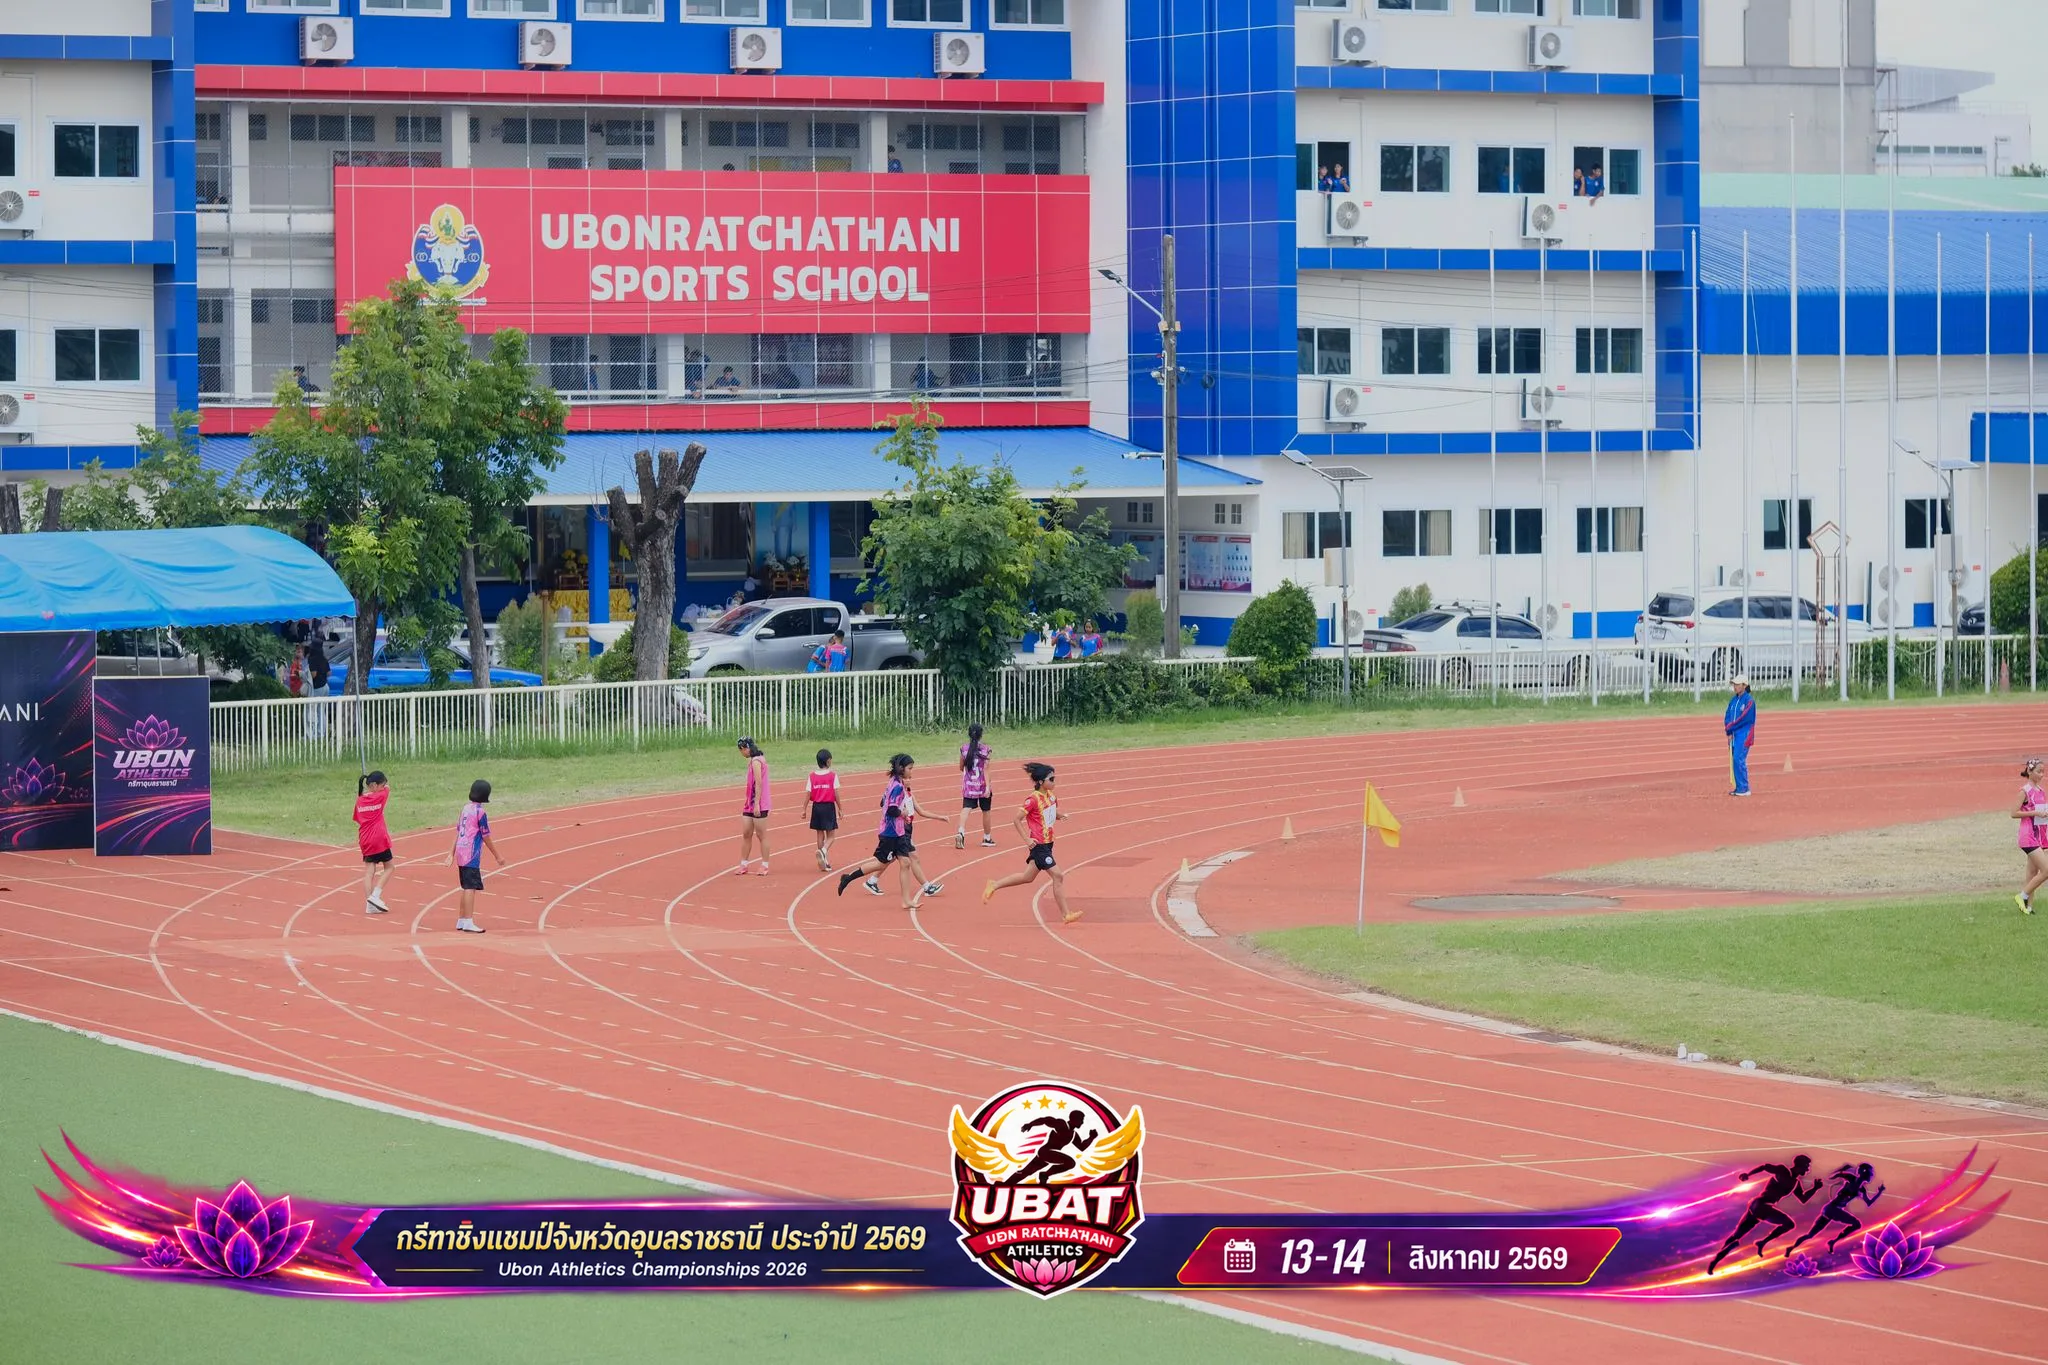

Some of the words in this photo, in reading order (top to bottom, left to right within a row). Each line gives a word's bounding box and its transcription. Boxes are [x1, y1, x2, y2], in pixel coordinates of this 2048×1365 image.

[541, 213, 960, 252] UBONRATCHATHANI
[591, 265, 749, 301] SPORTS
[773, 266, 929, 302] SCHOOL
[113, 749, 196, 769] UBON
[113, 767, 192, 780] ATHLETICS
